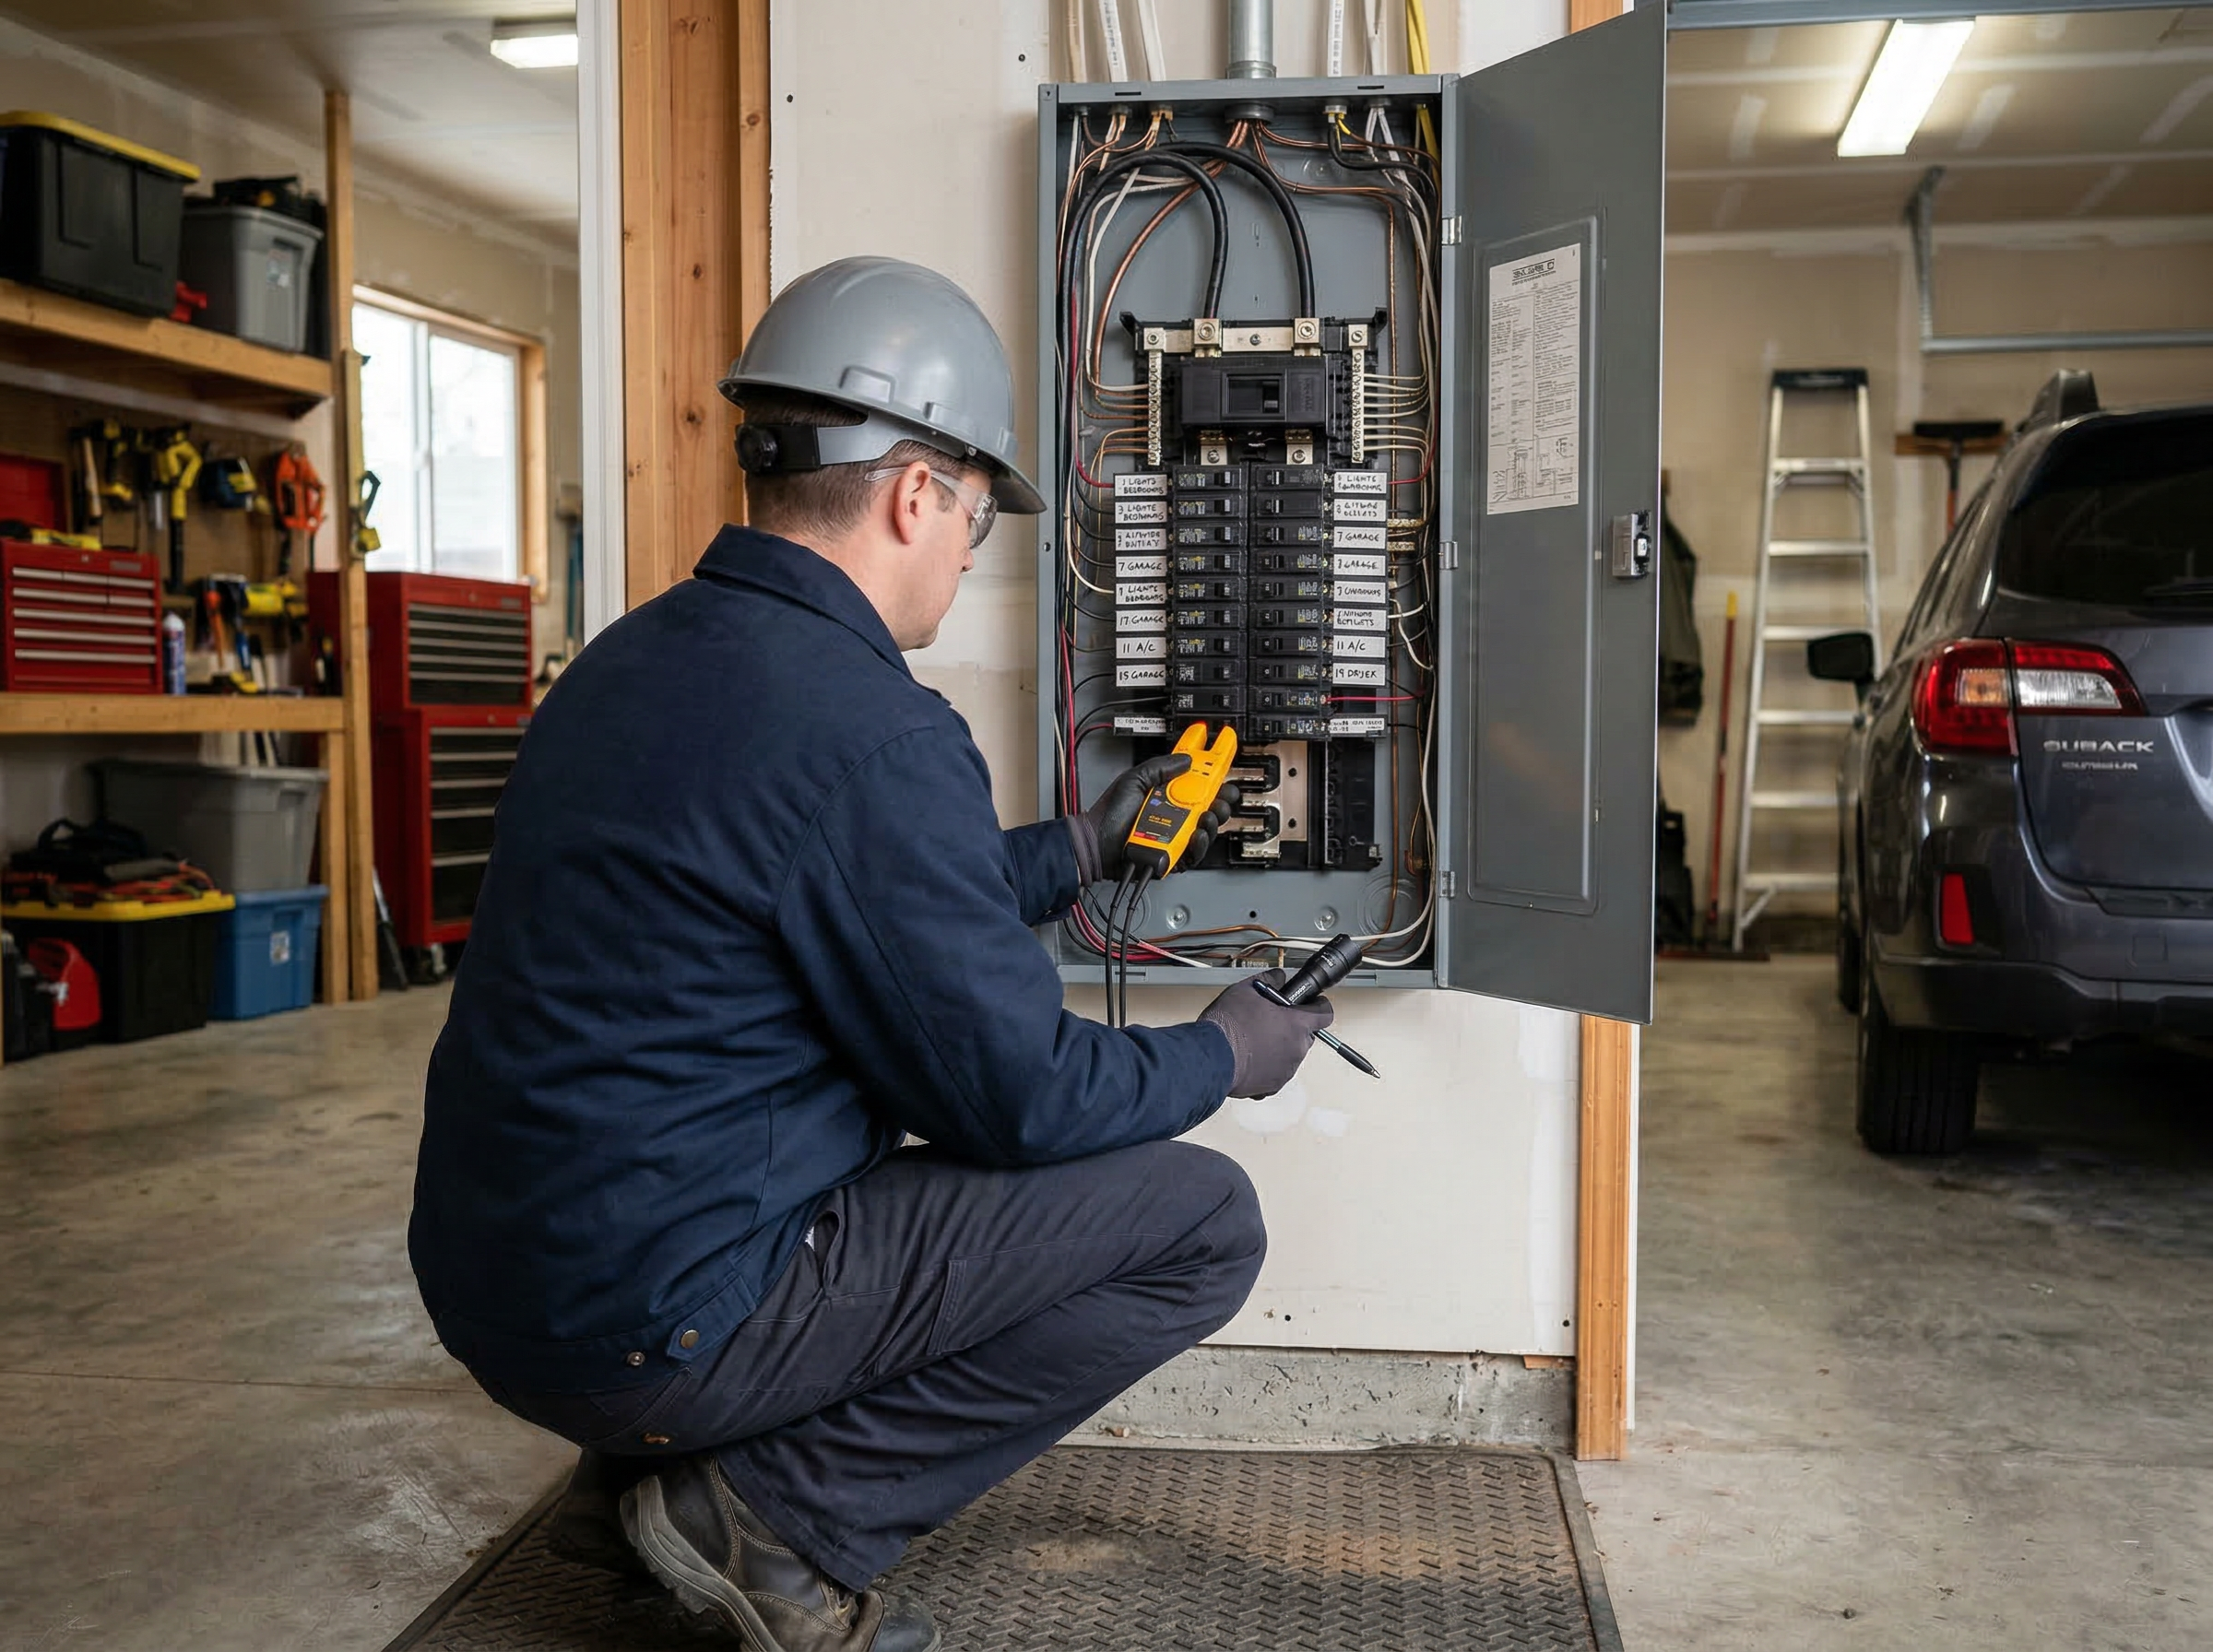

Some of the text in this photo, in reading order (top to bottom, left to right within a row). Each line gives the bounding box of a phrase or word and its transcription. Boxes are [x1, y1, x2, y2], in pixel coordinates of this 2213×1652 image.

[1344, 532, 1380, 542] GARAGE
[1118, 561, 1125, 572] 7
[1130, 615, 1165, 625] GARAGE
[1135, 639, 1157, 655] A/C
[1347, 639, 1367, 654] A/C
[1335, 667, 1345, 678] 19
